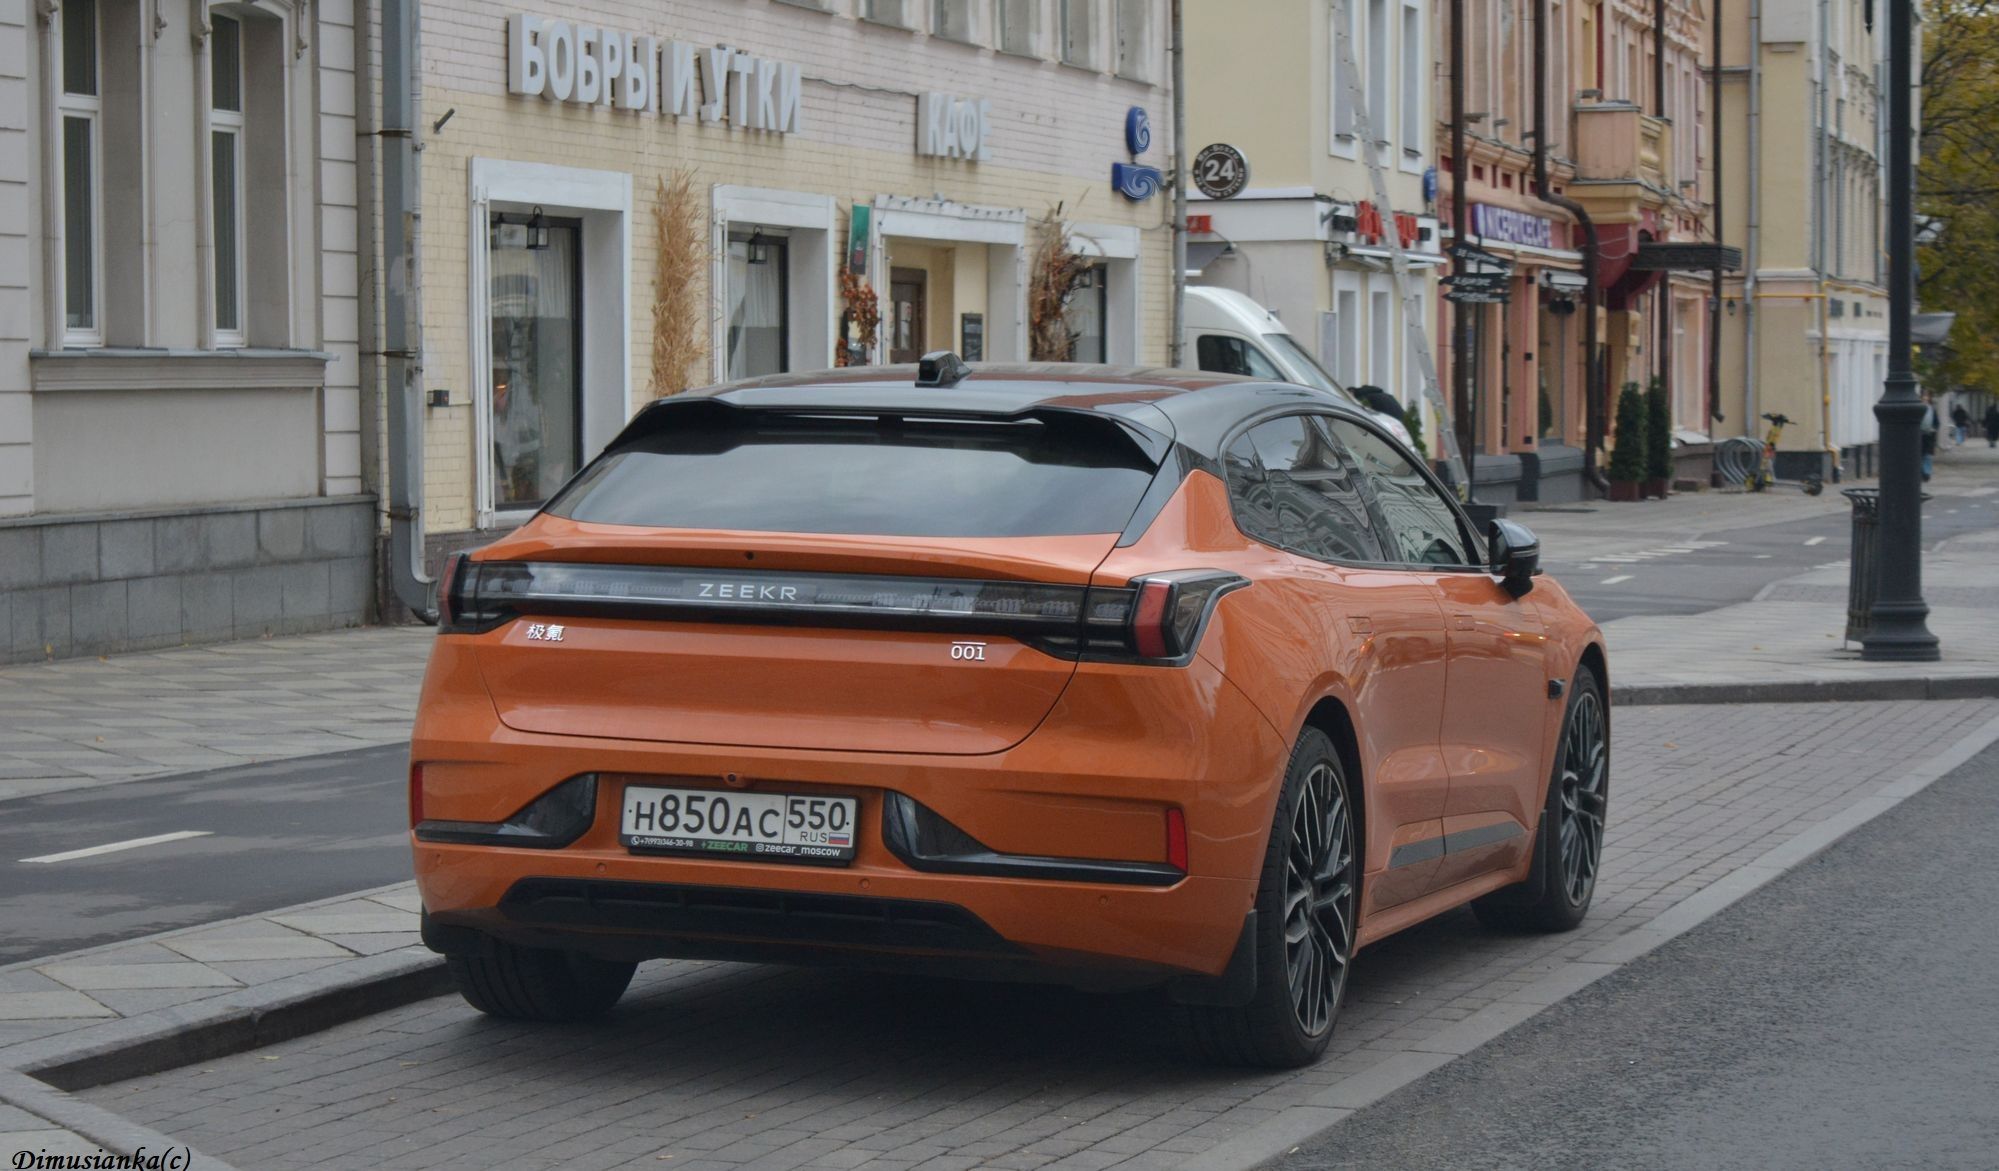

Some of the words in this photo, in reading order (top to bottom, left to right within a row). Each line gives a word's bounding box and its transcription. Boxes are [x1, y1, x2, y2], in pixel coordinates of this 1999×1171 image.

[509, 13, 656, 112] БОБРЫ
[661, 39, 695, 117] И
[700, 45, 802, 133] УТКИ
[918, 91, 992, 161] КАФЕ
[1205, 158, 1235, 181] 24
[699, 583, 798, 601] ZEEKR
[526, 623, 565, 642] 极氪
[950, 644, 986, 661] 001
[787, 799, 847, 831] 550
[707, 840, 749, 852] ZEECAR
[799, 831, 828, 843] RUS
[764, 844, 841, 857] zeecar_moscow
